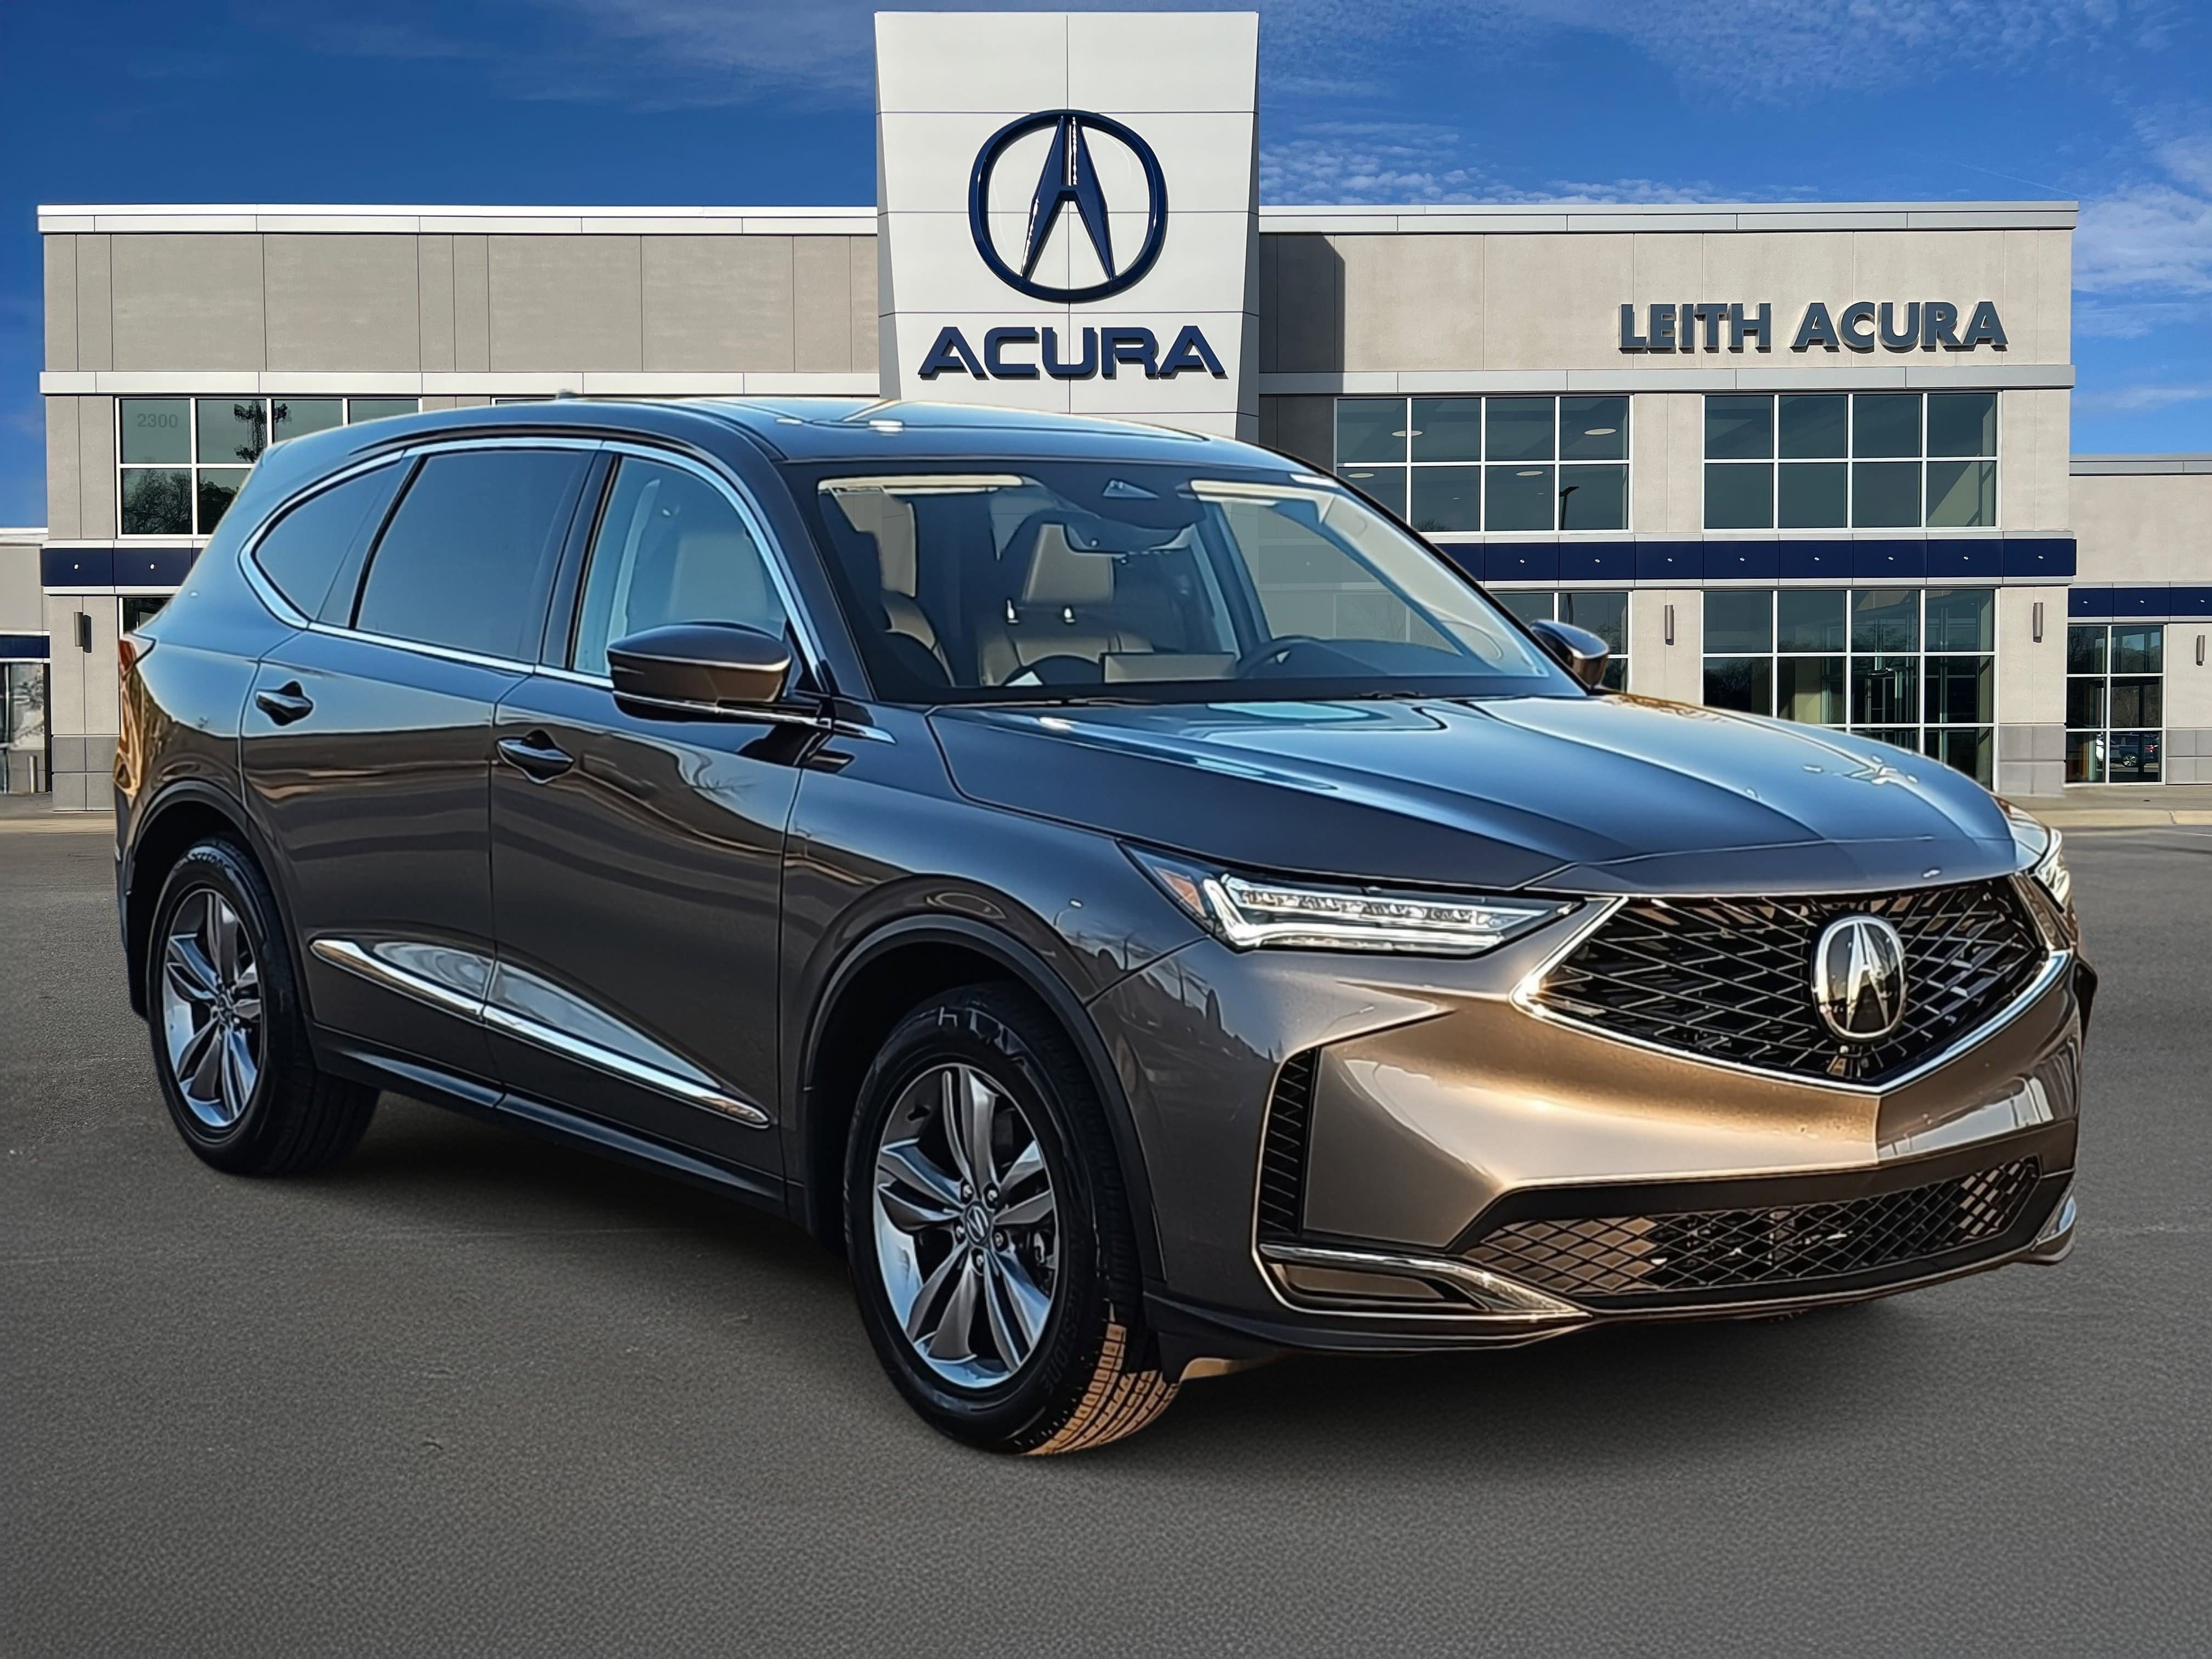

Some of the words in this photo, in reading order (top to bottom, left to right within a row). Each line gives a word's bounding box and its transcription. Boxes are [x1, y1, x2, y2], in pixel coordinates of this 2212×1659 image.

[918, 326, 1228, 380] ACURA
[1619, 303, 1771, 353] LEITH
[1790, 301, 2008, 353] ACURA
[137, 413, 178, 428] 2300
